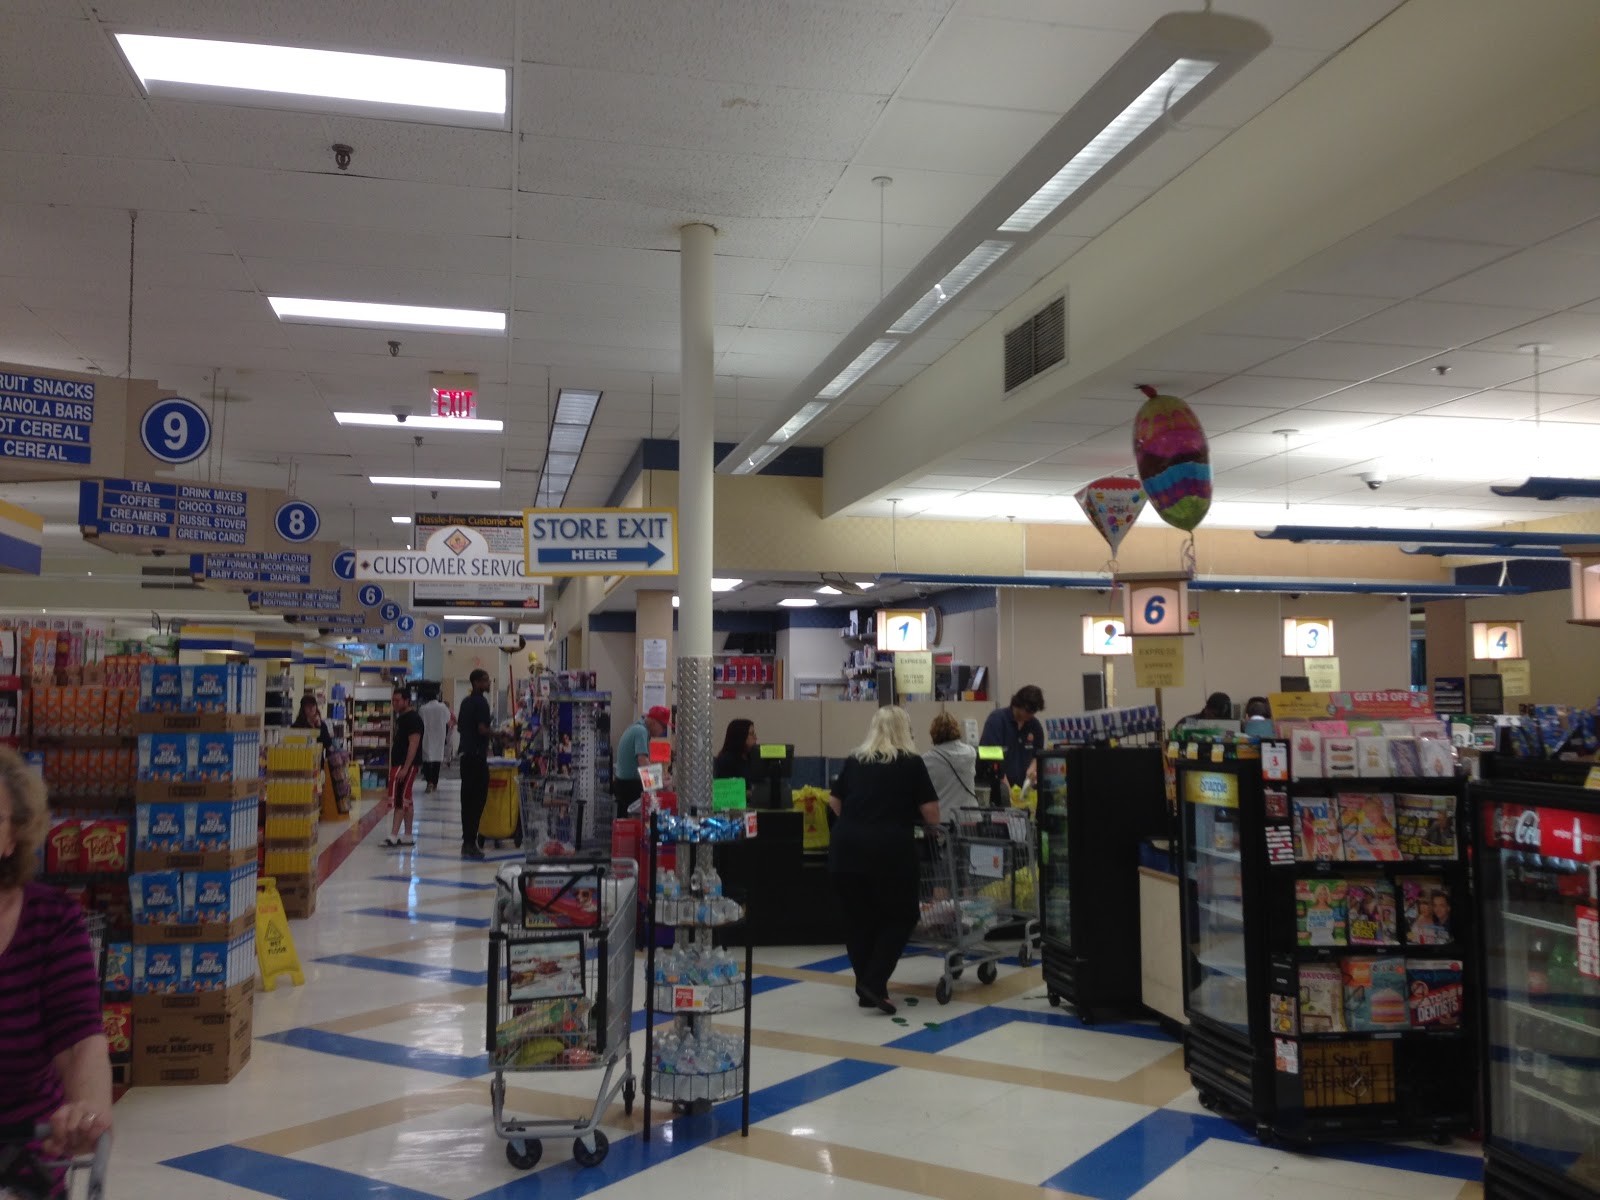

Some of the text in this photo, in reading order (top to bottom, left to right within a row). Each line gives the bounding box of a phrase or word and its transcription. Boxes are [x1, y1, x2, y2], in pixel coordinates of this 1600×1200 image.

[33, 378, 94, 400] SNACKS
[0, 396, 92, 420] ANOLA BARS
[437, 390, 473, 417] EXIT
[20, 420, 83, 441] CEREAL
[163, 411, 188, 451] 9
[4, 440, 67, 460] CEREAL
[130, 481, 151, 493] TEA
[182, 487, 243, 502] DRINK MIXES
[120, 494, 160, 507] COFFEE
[110, 508, 167, 522] CREAMERS
[216, 503, 245, 516] SYRUP
[179, 514, 246, 530] RUSSEL STOVER
[288, 509, 306, 535] 8
[418, 515, 466, 525] Hassle-Free
[468, 516, 507, 526] Customer
[532, 517, 668, 539] STORE EXIT
[109, 522, 157, 537] ICED TEA
[178, 527, 245, 544] GREETING CARDS
[283, 554, 308, 563] CLOTHS
[571, 549, 618, 560] HERE
[207, 559, 258, 569] BABY FORMULA
[261, 563, 309, 572] INCONTINENCE
[343, 557, 356, 576] 7
[373, 556, 526, 577] CUSTOMER SERVIC
[211, 570, 254, 580] BABY FOOD
[270, 574, 301, 583] DIAPERS
[365, 588, 376, 603] 6
[386, 607, 394, 618] 5
[1144, 595, 1166, 625] 6
[401, 618, 409, 629] 4
[428, 626, 436, 636] 3
[898, 621, 910, 641] 1
[455, 636, 505, 644] PHARMACY
[1104, 624, 1117, 646] 2
[1306, 628, 1319, 649] 3
[1496, 631, 1509, 651] 4
[1139, 647, 1177, 656] EXPRESS
[1353, 692, 1409, 701] GET $2 OFF
[1200, 776, 1228, 796] Snapple
[171, 1043, 215, 1055] KRISPIES
